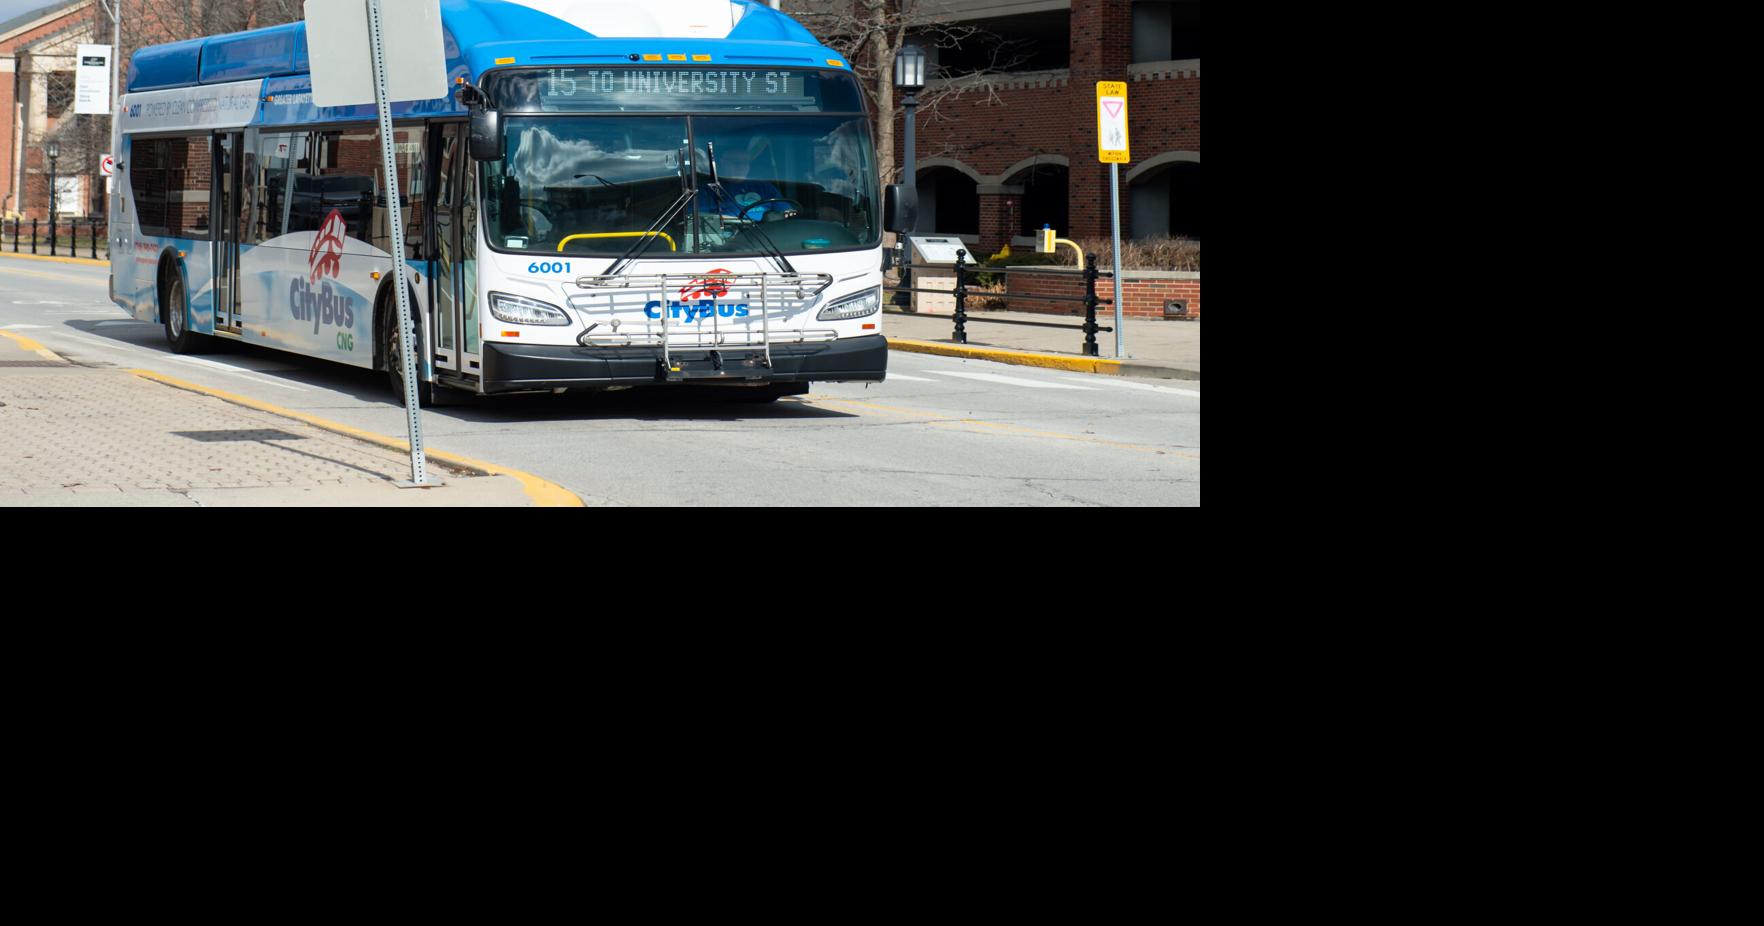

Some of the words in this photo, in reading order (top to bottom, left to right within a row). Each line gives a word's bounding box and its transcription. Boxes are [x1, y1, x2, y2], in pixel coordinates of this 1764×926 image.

[547, 69, 577, 96] 15
[588, 70, 615, 93] TO
[623, 71, 756, 94] UNIVERSITY
[765, 71, 791, 94] ST
[129, 103, 142, 118] 6001
[527, 262, 571, 274] 6001
[289, 276, 354, 335] CityBus
[643, 299, 749, 323] CityBus
[336, 331, 354, 351] CNG
